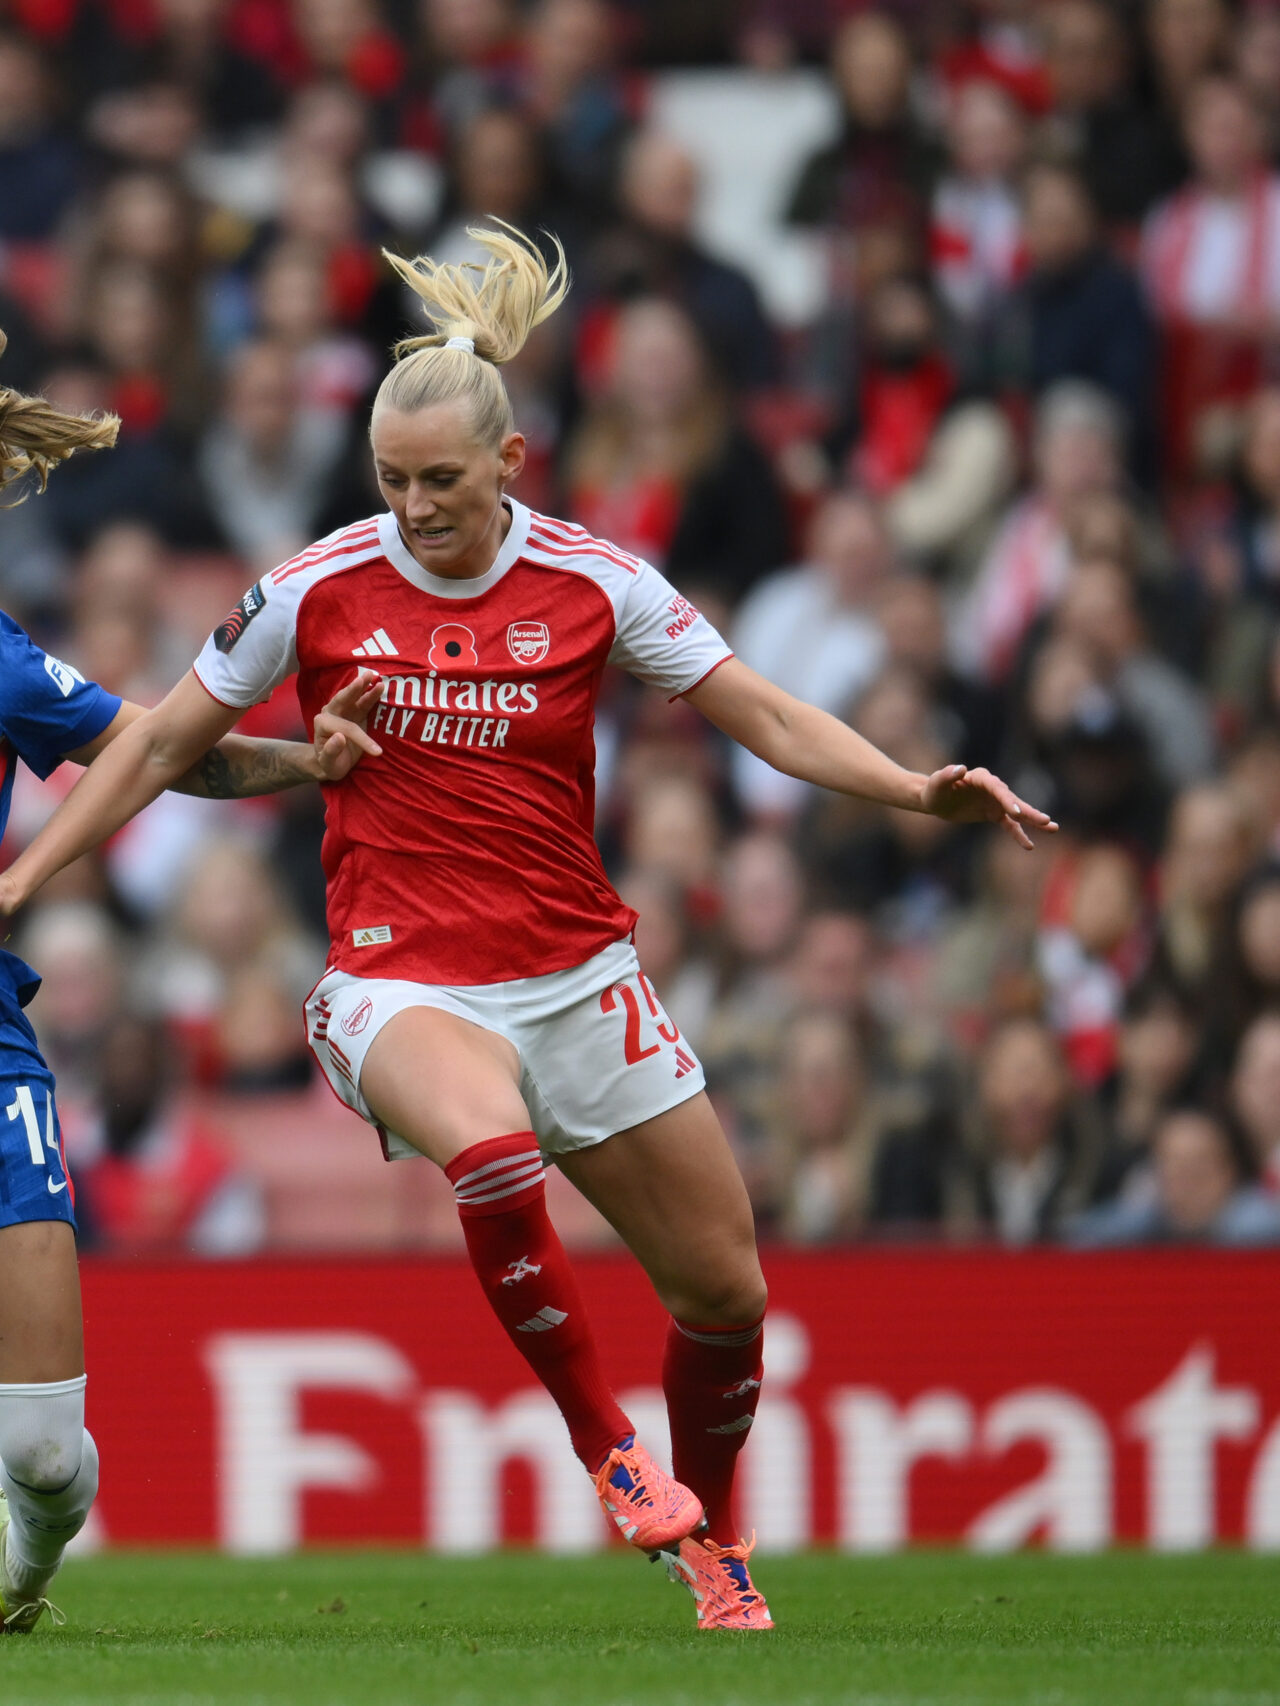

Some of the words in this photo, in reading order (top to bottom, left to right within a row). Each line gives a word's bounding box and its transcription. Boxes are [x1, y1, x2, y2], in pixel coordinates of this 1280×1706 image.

[513, 629, 544, 638] Arsenal
[357, 665, 539, 714] mirates
[373, 703, 416, 738] FLY
[420, 712, 510, 748] BETTER
[599, 969, 680, 1066] 25
